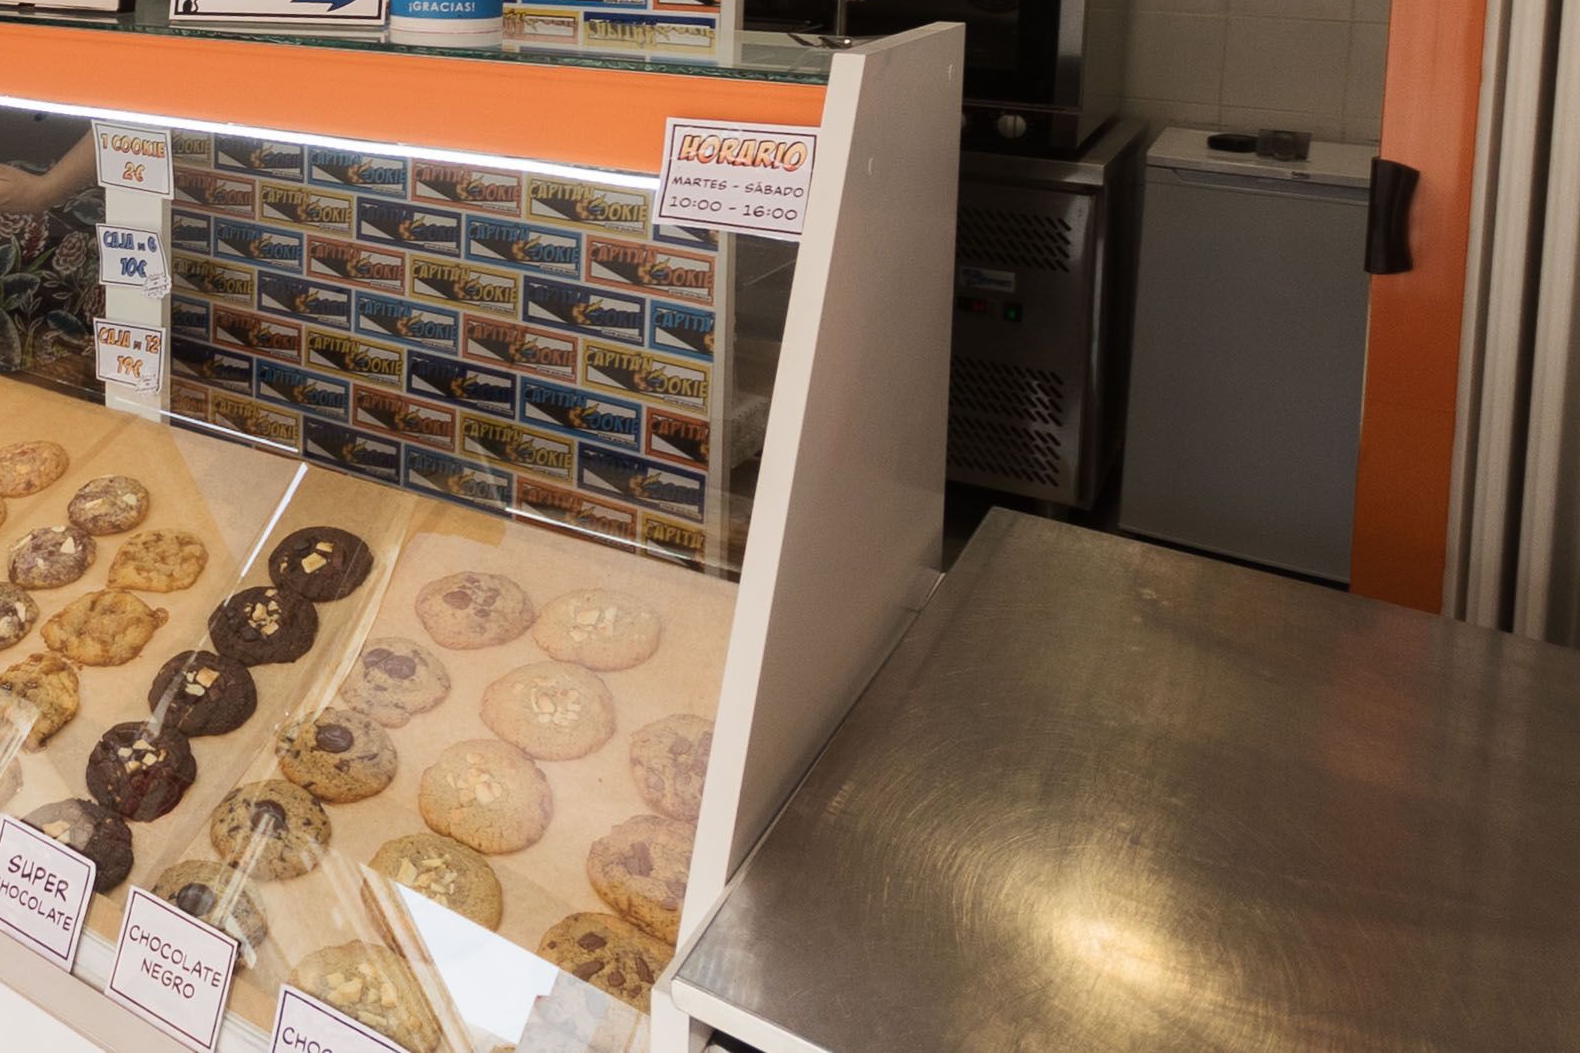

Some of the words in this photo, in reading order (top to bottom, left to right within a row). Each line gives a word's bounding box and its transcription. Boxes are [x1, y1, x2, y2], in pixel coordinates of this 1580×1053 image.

[409, 1, 475, 12] ¡GRACIAS!
[112, 135, 166, 159] COOKIE
[678, 134, 808, 172] HORARIO
[122, 161, 145, 183] 2€
[672, 176, 728, 191] MARTES
[744, 182, 804, 198] SÁBADO
[670, 196, 722, 212] 10:00
[742, 205, 797, 221] 16:00
[103, 230, 135, 251] CAJA
[147, 236, 157, 253] 6
[120, 257, 147, 278] 10€
[98, 326, 131, 348] CAJA
[145, 334, 161, 355] 12
[116, 355, 143, 378] 19€
[7, 853, 70, 903] SUPER
[128, 924, 222, 989] CHOCOLATE
[140, 958, 196, 1001] NEGRO
